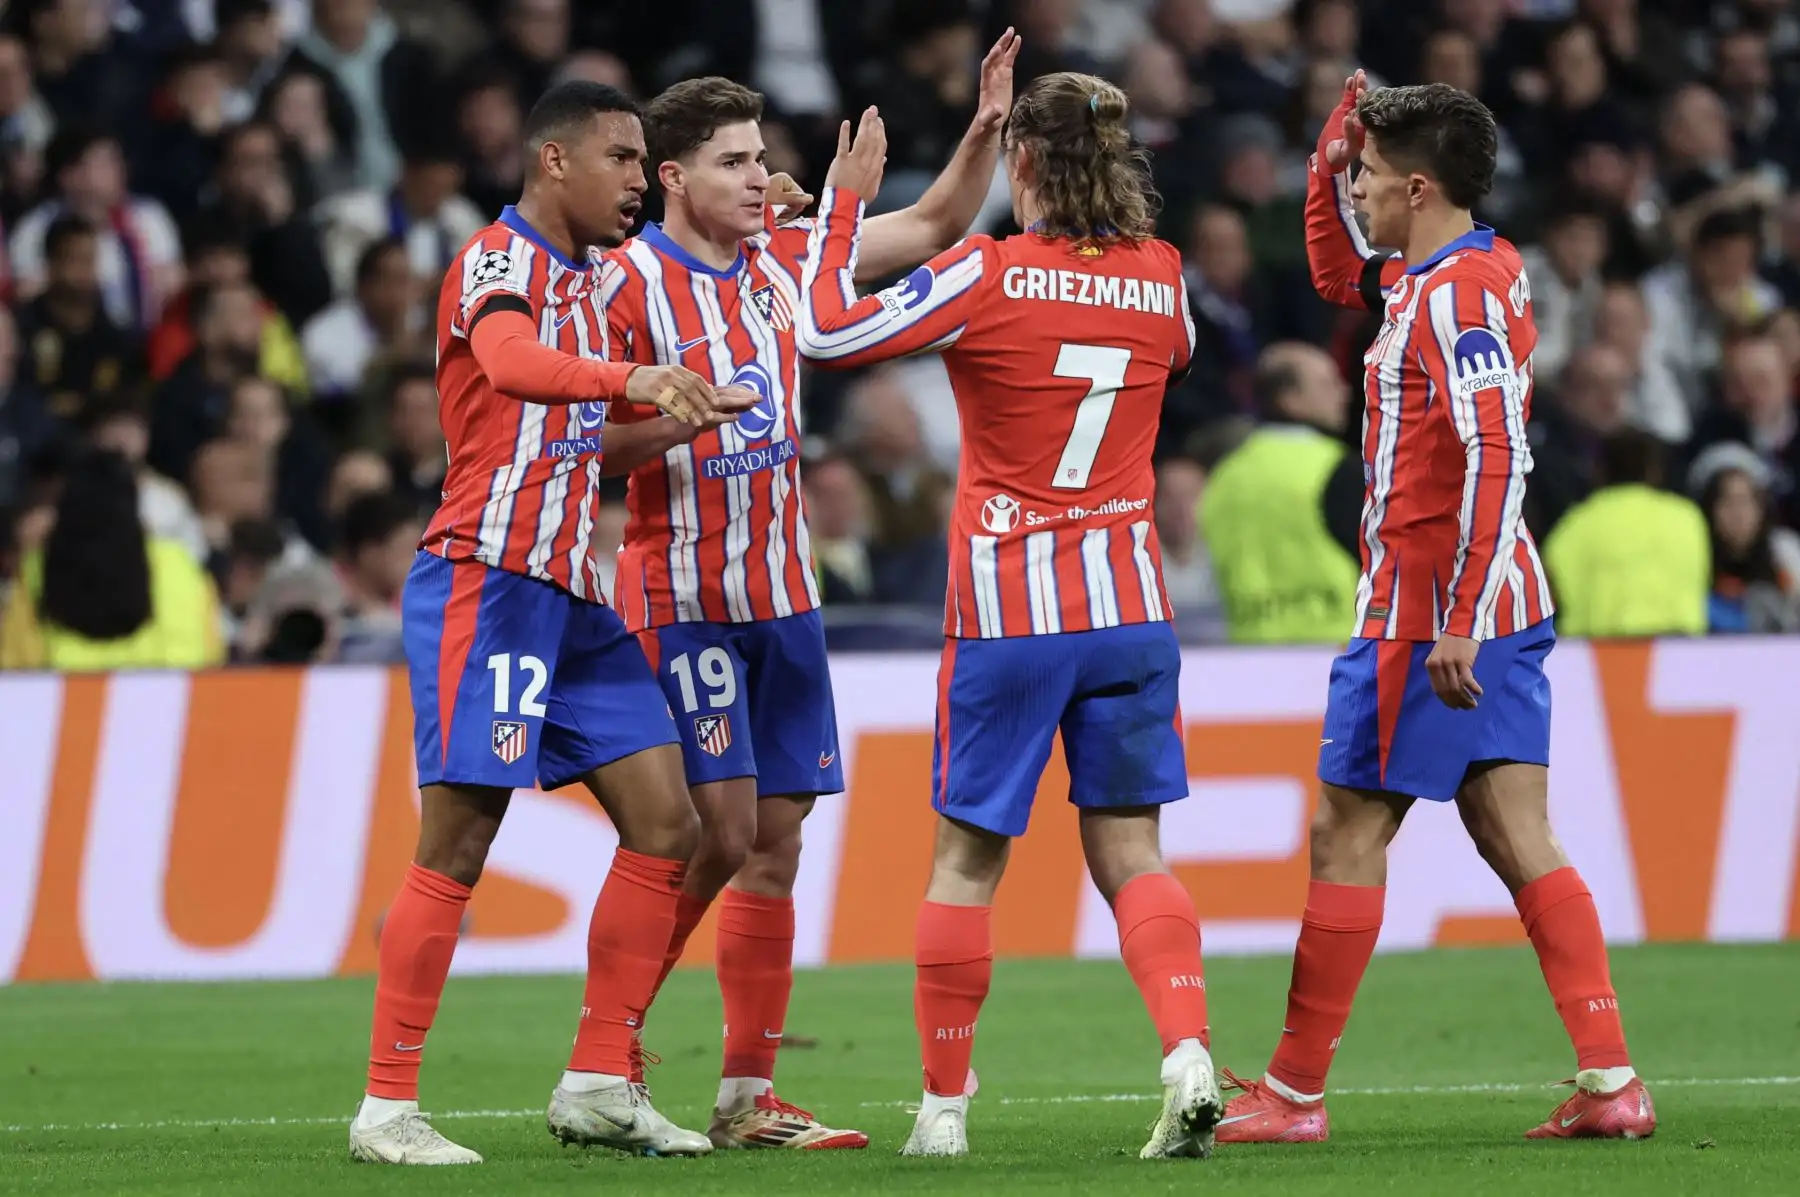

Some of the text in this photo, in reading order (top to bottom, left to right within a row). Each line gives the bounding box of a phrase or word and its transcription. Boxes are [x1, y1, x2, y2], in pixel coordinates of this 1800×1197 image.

[1003, 266, 1175, 318] GRIEZMANN
[1460, 373, 1511, 394] kraken
[1051, 343, 1132, 489] 7
[707, 440, 794, 477] RIYADH AIR
[487, 653, 548, 718] 12
[670, 647, 737, 713] 19
